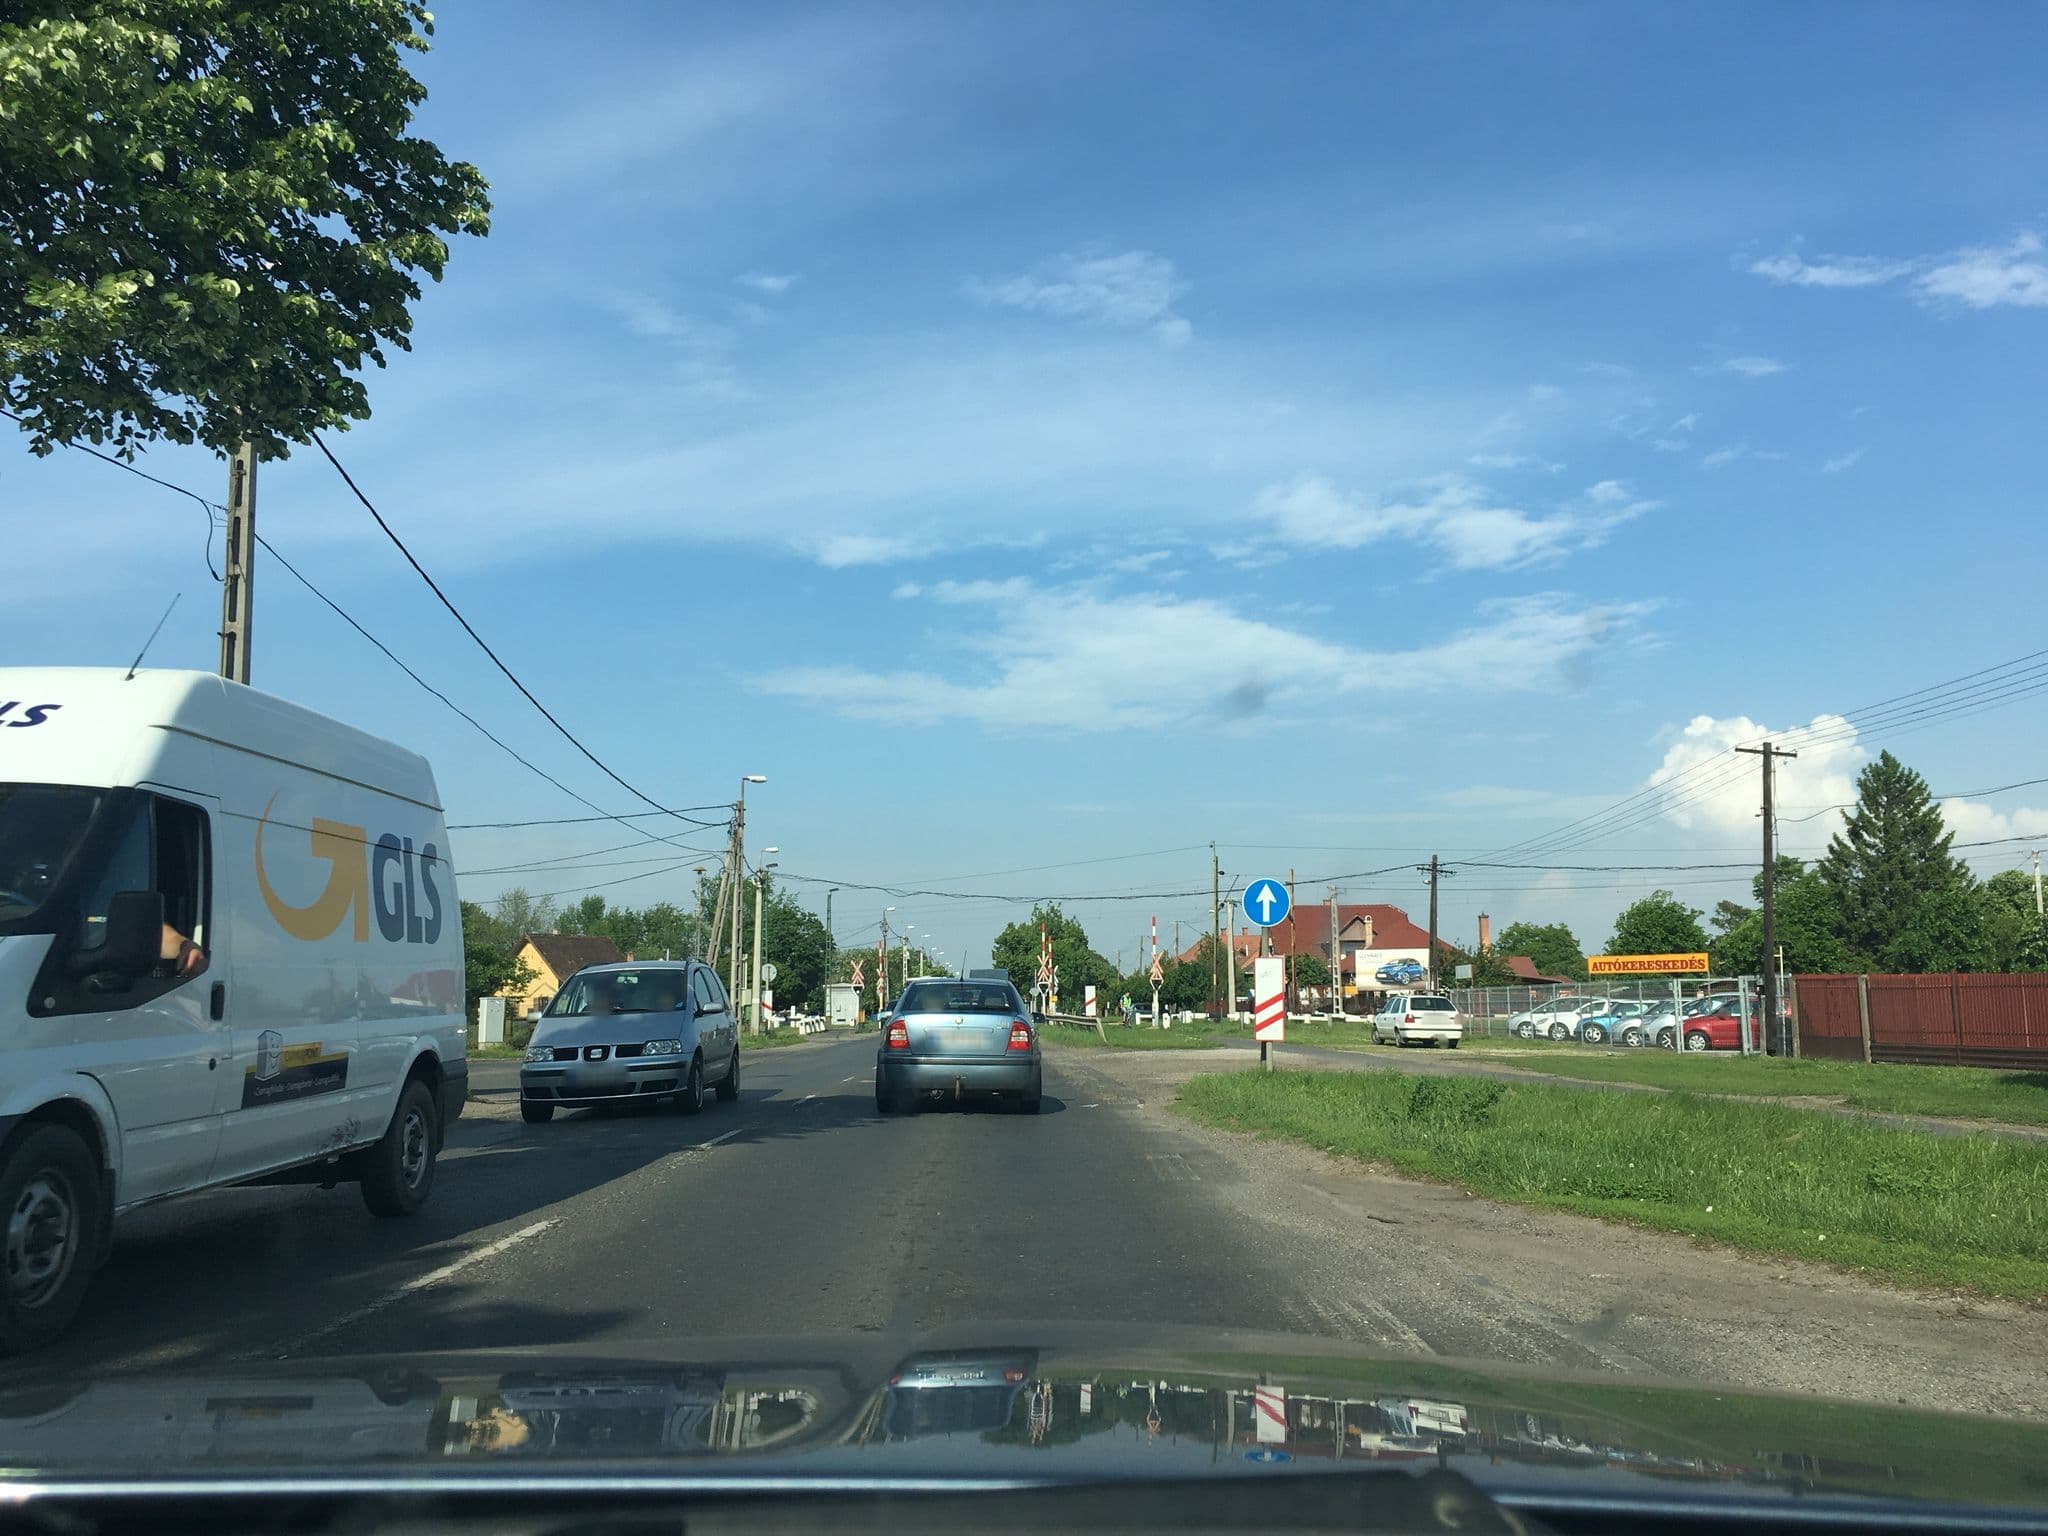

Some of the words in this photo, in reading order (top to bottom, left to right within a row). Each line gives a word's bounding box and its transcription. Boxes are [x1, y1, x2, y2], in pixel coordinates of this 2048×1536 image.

[0, 701, 64, 728] LS
[372, 833, 442, 945] GLS
[1591, 956, 1706, 972] AUTÓKERESKEDÉS
